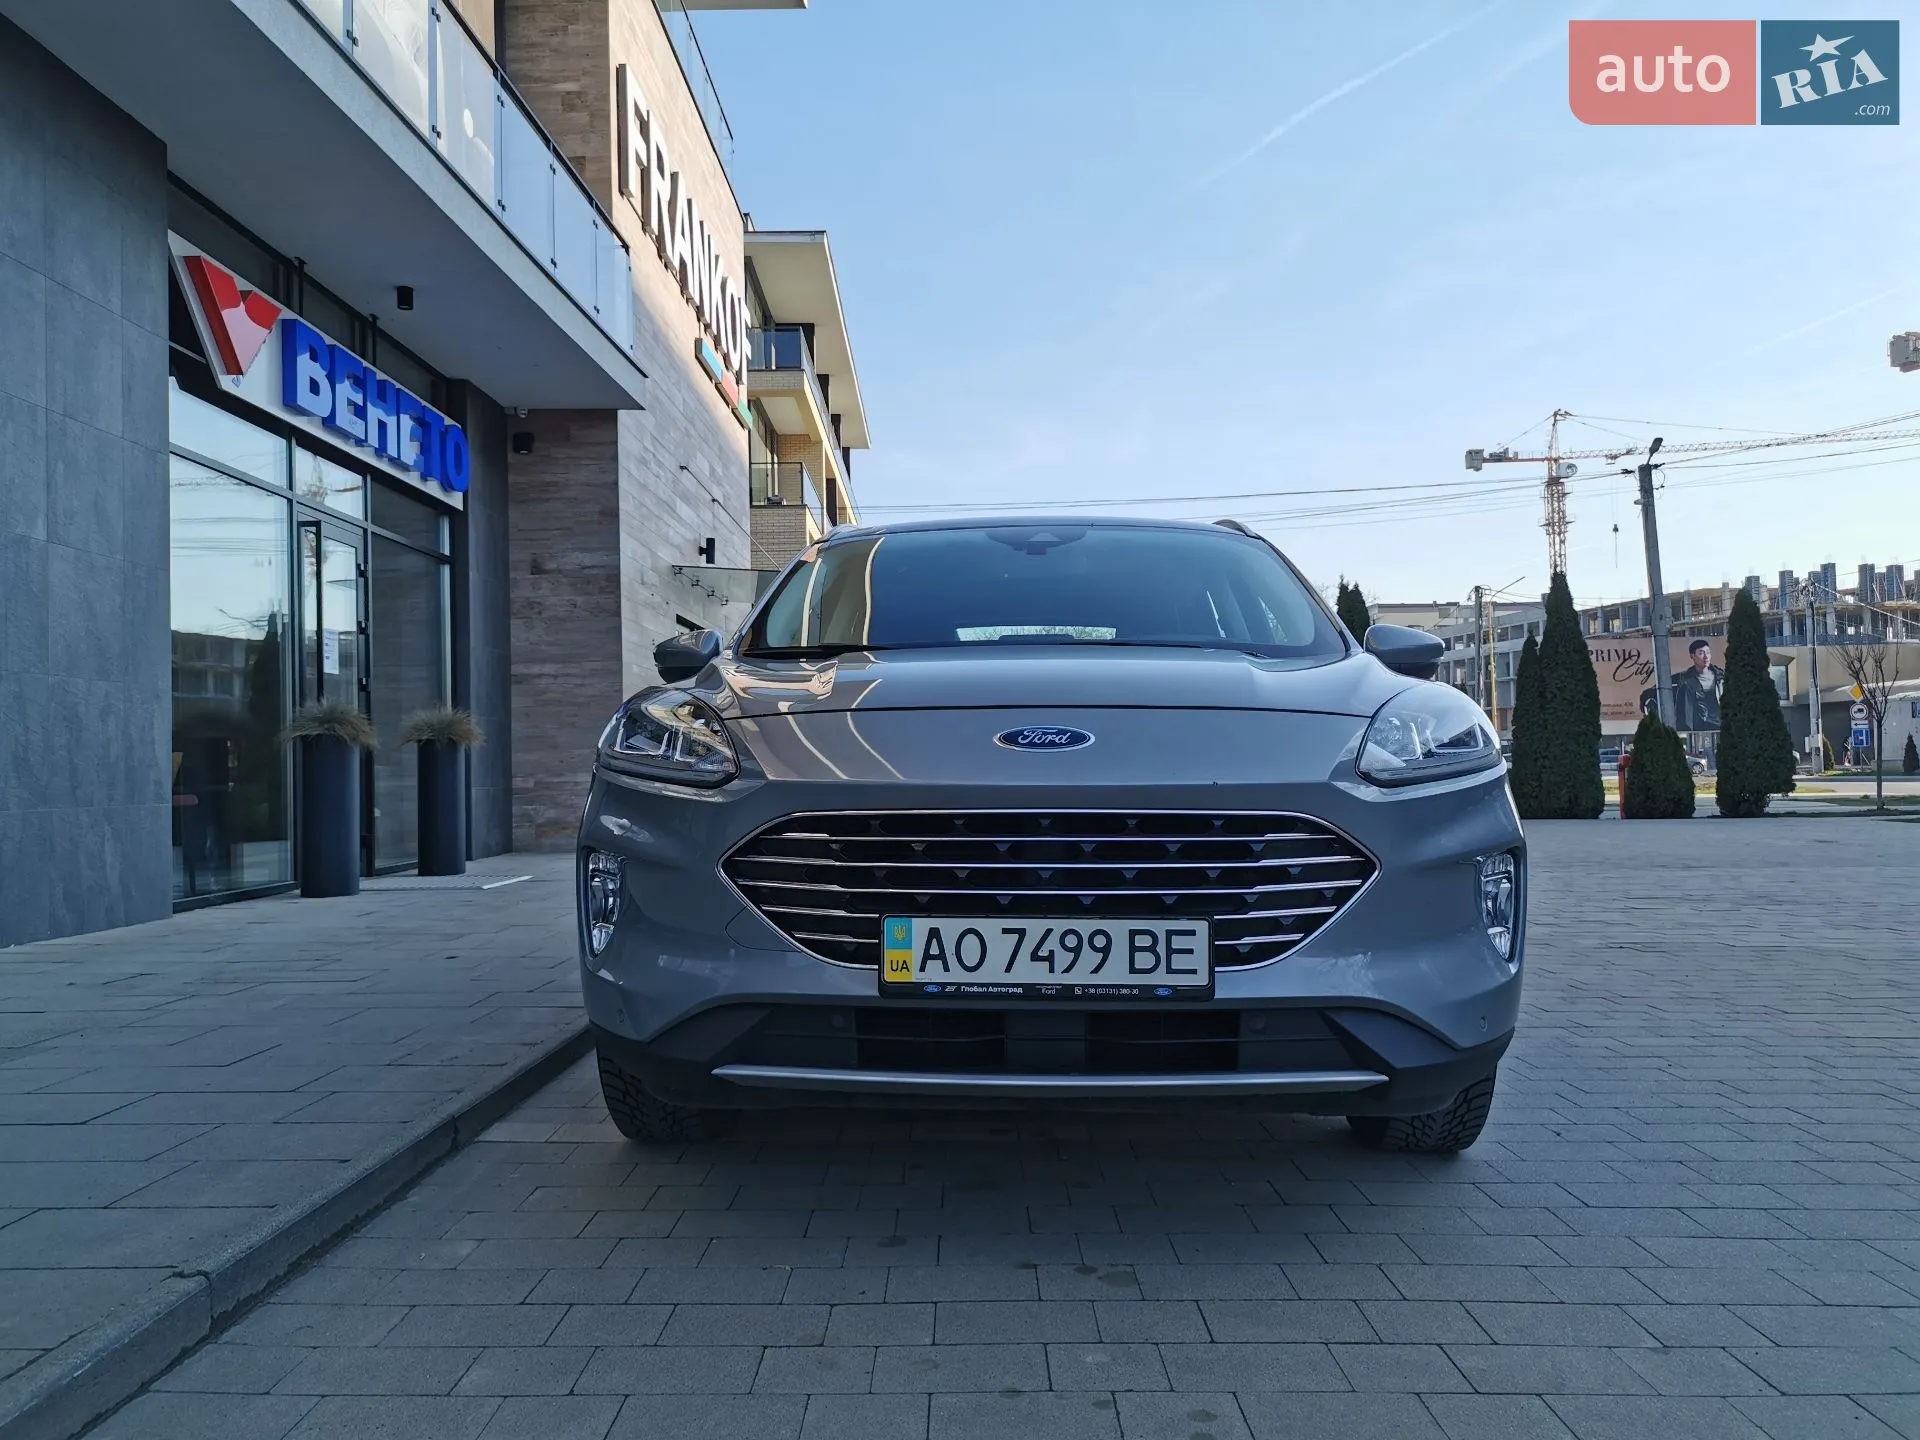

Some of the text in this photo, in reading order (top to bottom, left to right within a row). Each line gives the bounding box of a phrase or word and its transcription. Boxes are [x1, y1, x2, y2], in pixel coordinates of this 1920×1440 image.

[617, 63, 752, 385] FRANKOF
[282, 319, 470, 493] ВЕНЕТО
[1613, 654, 1655, 685] City
[1018, 729, 1071, 744] Ford
[890, 959, 910, 972] UA
[919, 927, 1197, 974] AO 7499 BE
